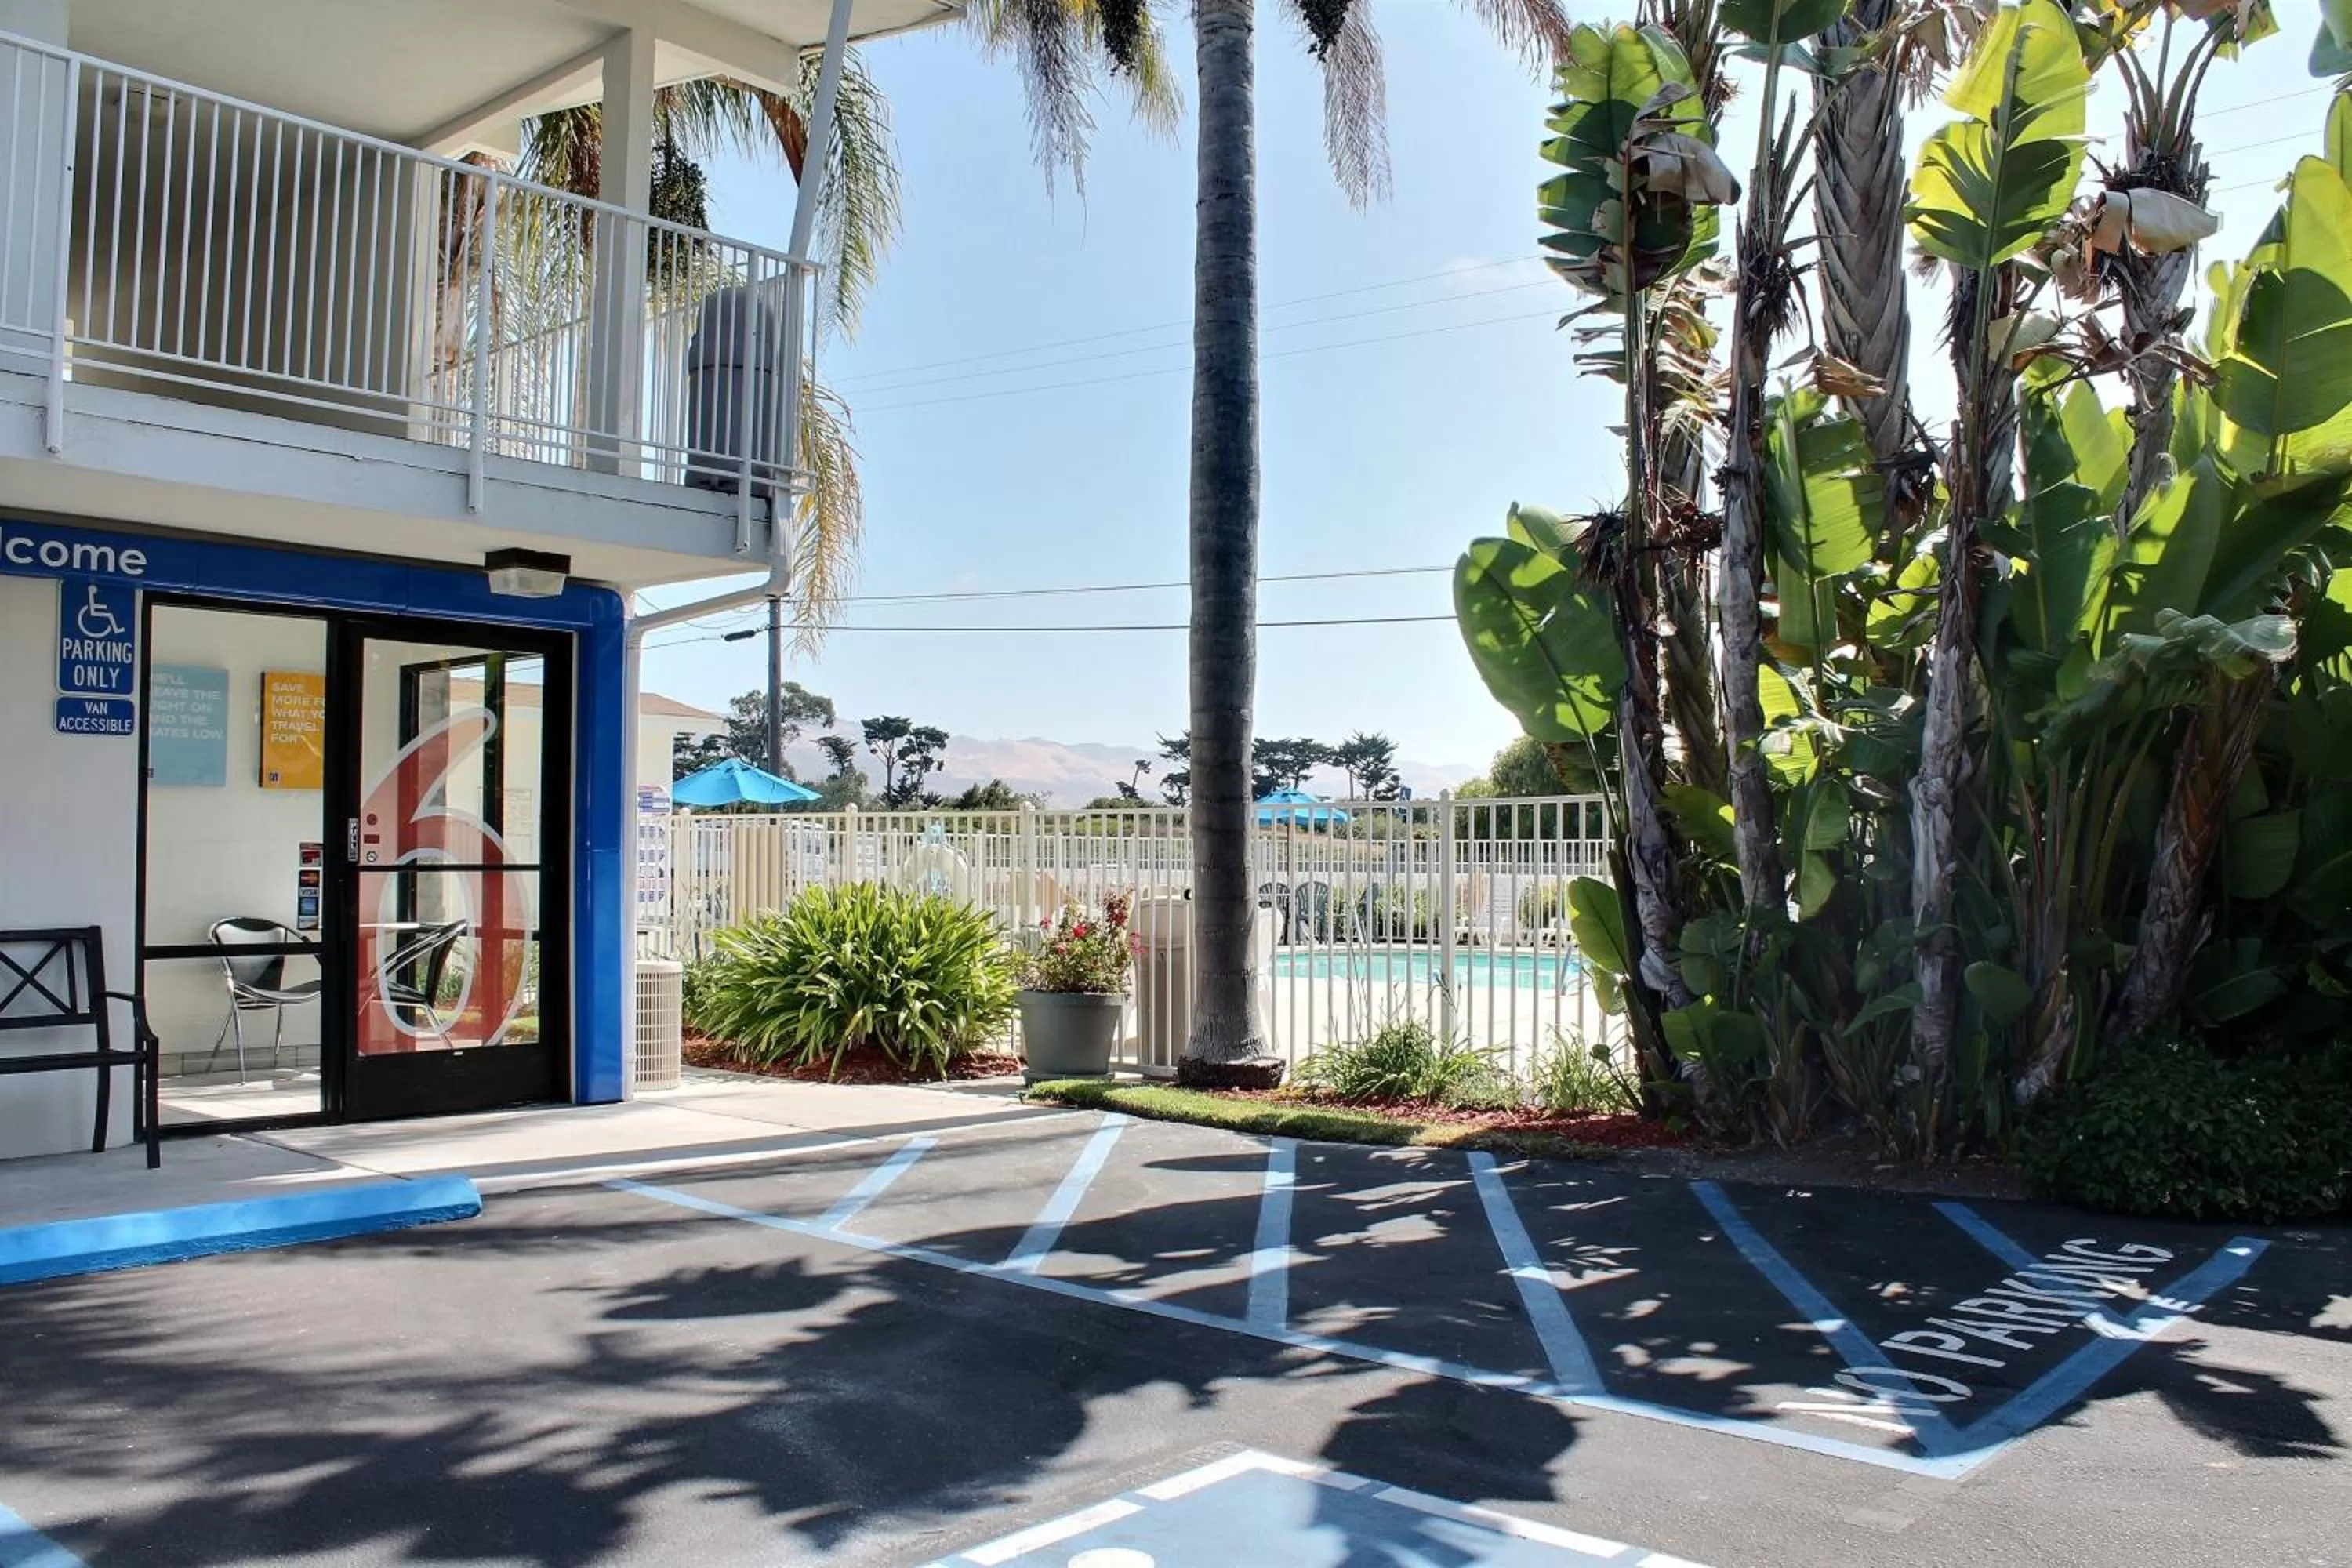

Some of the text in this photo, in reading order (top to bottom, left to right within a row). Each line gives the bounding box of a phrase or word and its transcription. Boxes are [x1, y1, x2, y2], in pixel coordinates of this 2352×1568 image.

[62, 637, 132, 664] PARKING
[74, 664, 120, 689] ONLY
[152, 686, 221, 702] EAVE THE
[270, 683, 304, 692] SAVE
[85, 701, 108, 715] VAN
[151, 699, 213, 714] IGHT ON
[272, 695, 311, 706] MORE
[272, 708, 306, 720] WHAT
[59, 716, 132, 733] ACCESSIBLE
[270, 720, 321, 733] TRAVEL
[1879, 1237, 2174, 1369] PARKING
